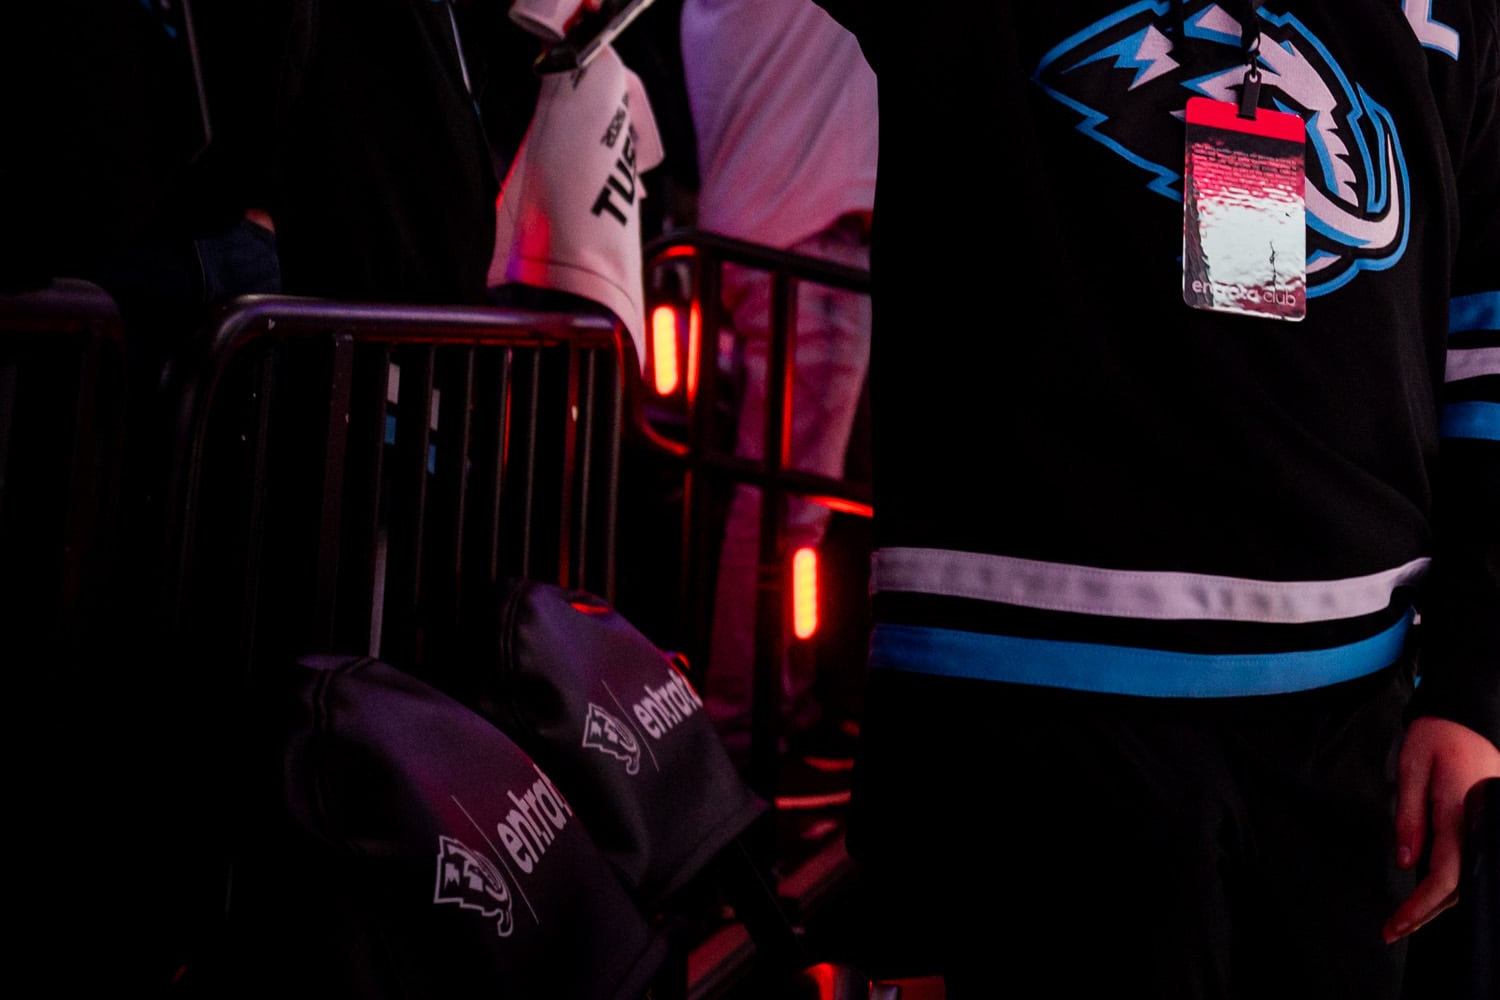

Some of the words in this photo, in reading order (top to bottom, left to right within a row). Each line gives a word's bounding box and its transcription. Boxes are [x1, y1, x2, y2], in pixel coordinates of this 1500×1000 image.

[590, 122, 639, 227] TUS
[1191, 279, 1261, 304] enata
[1263, 289, 1297, 307] club
[632, 668, 704, 740] entrat
